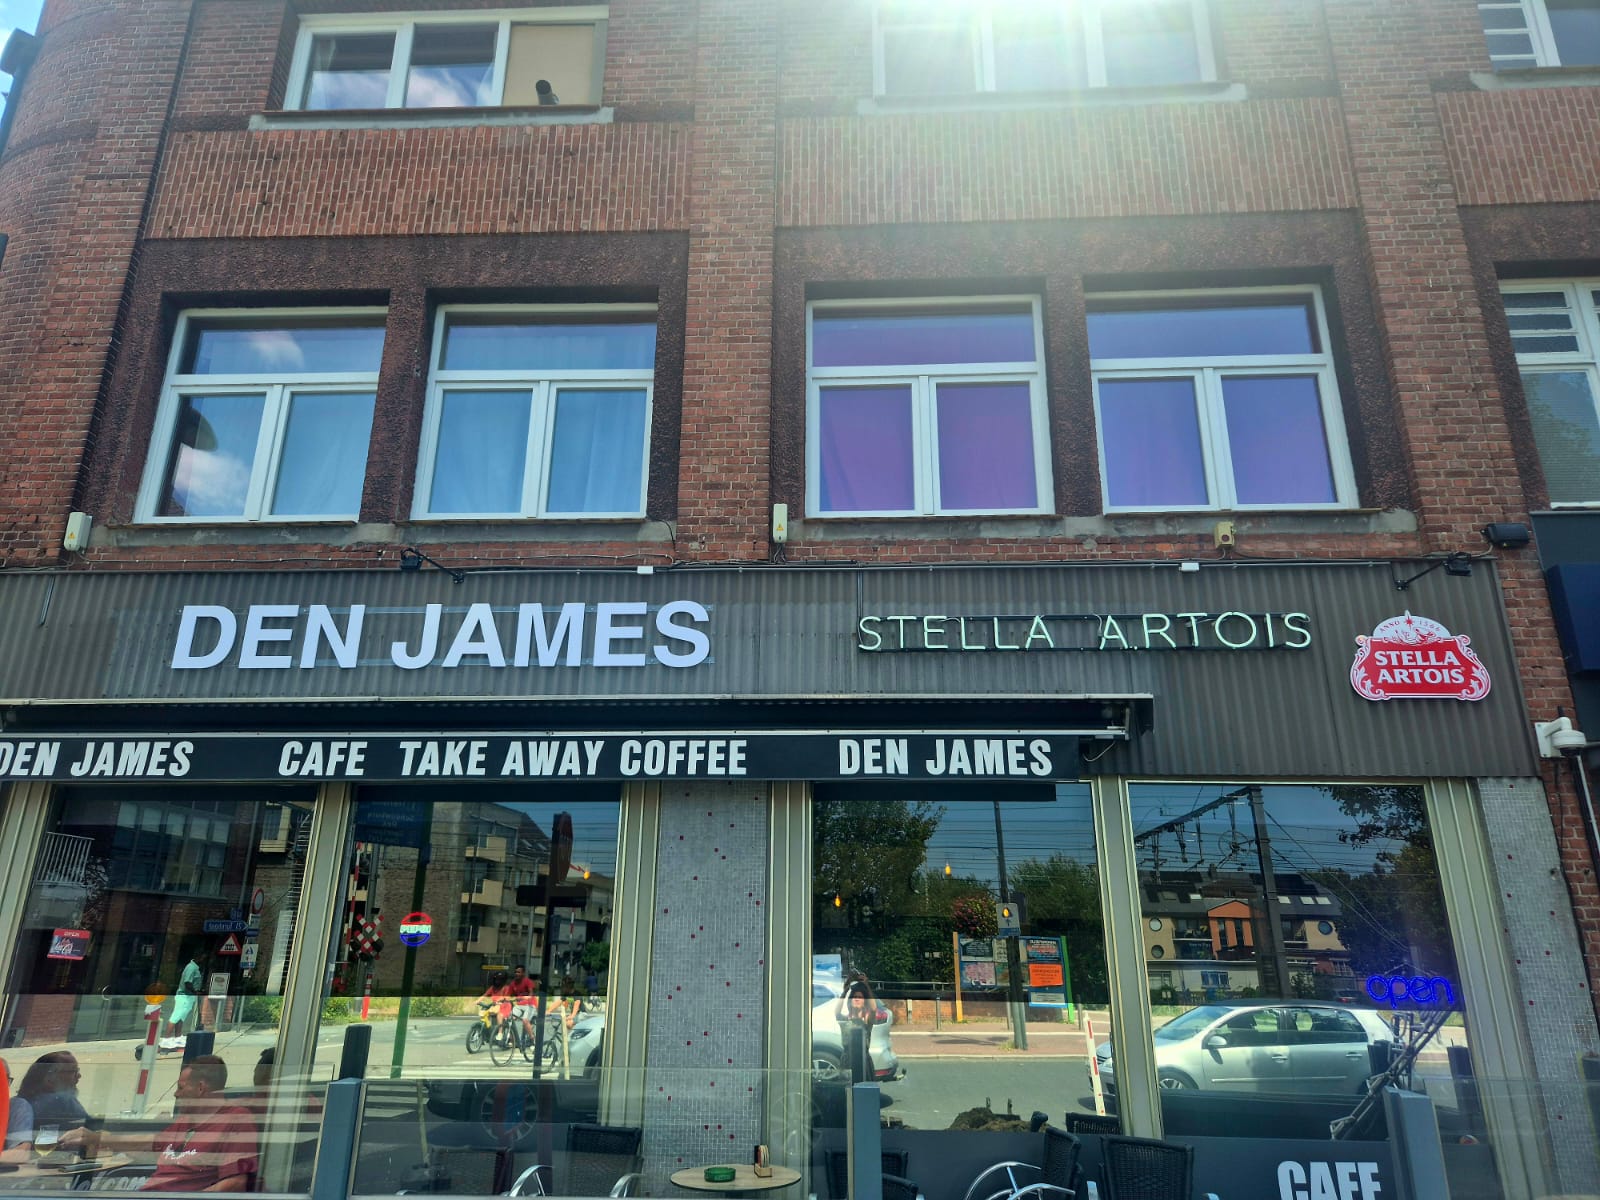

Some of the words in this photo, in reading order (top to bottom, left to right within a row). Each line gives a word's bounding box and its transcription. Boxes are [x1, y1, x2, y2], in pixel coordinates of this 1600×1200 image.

[171, 604, 366, 670] DEN
[390, 600, 711, 670] JAMES
[858, 615, 1055, 650] STELLA
[1100, 611, 1312, 650] ARTOIS
[1374, 650, 1462, 666] STELLA
[1377, 668, 1466, 684] ARTOIS
[70, 740, 194, 778] JAMES
[278, 740, 367, 778] CAFE
[399, 740, 487, 777] TAKE
[500, 740, 604, 777] AWAY
[619, 739, 749, 777] COFFEE
[838, 739, 910, 777] DEN
[925, 738, 1054, 777] JAMES
[1366, 974, 1455, 1009] open
